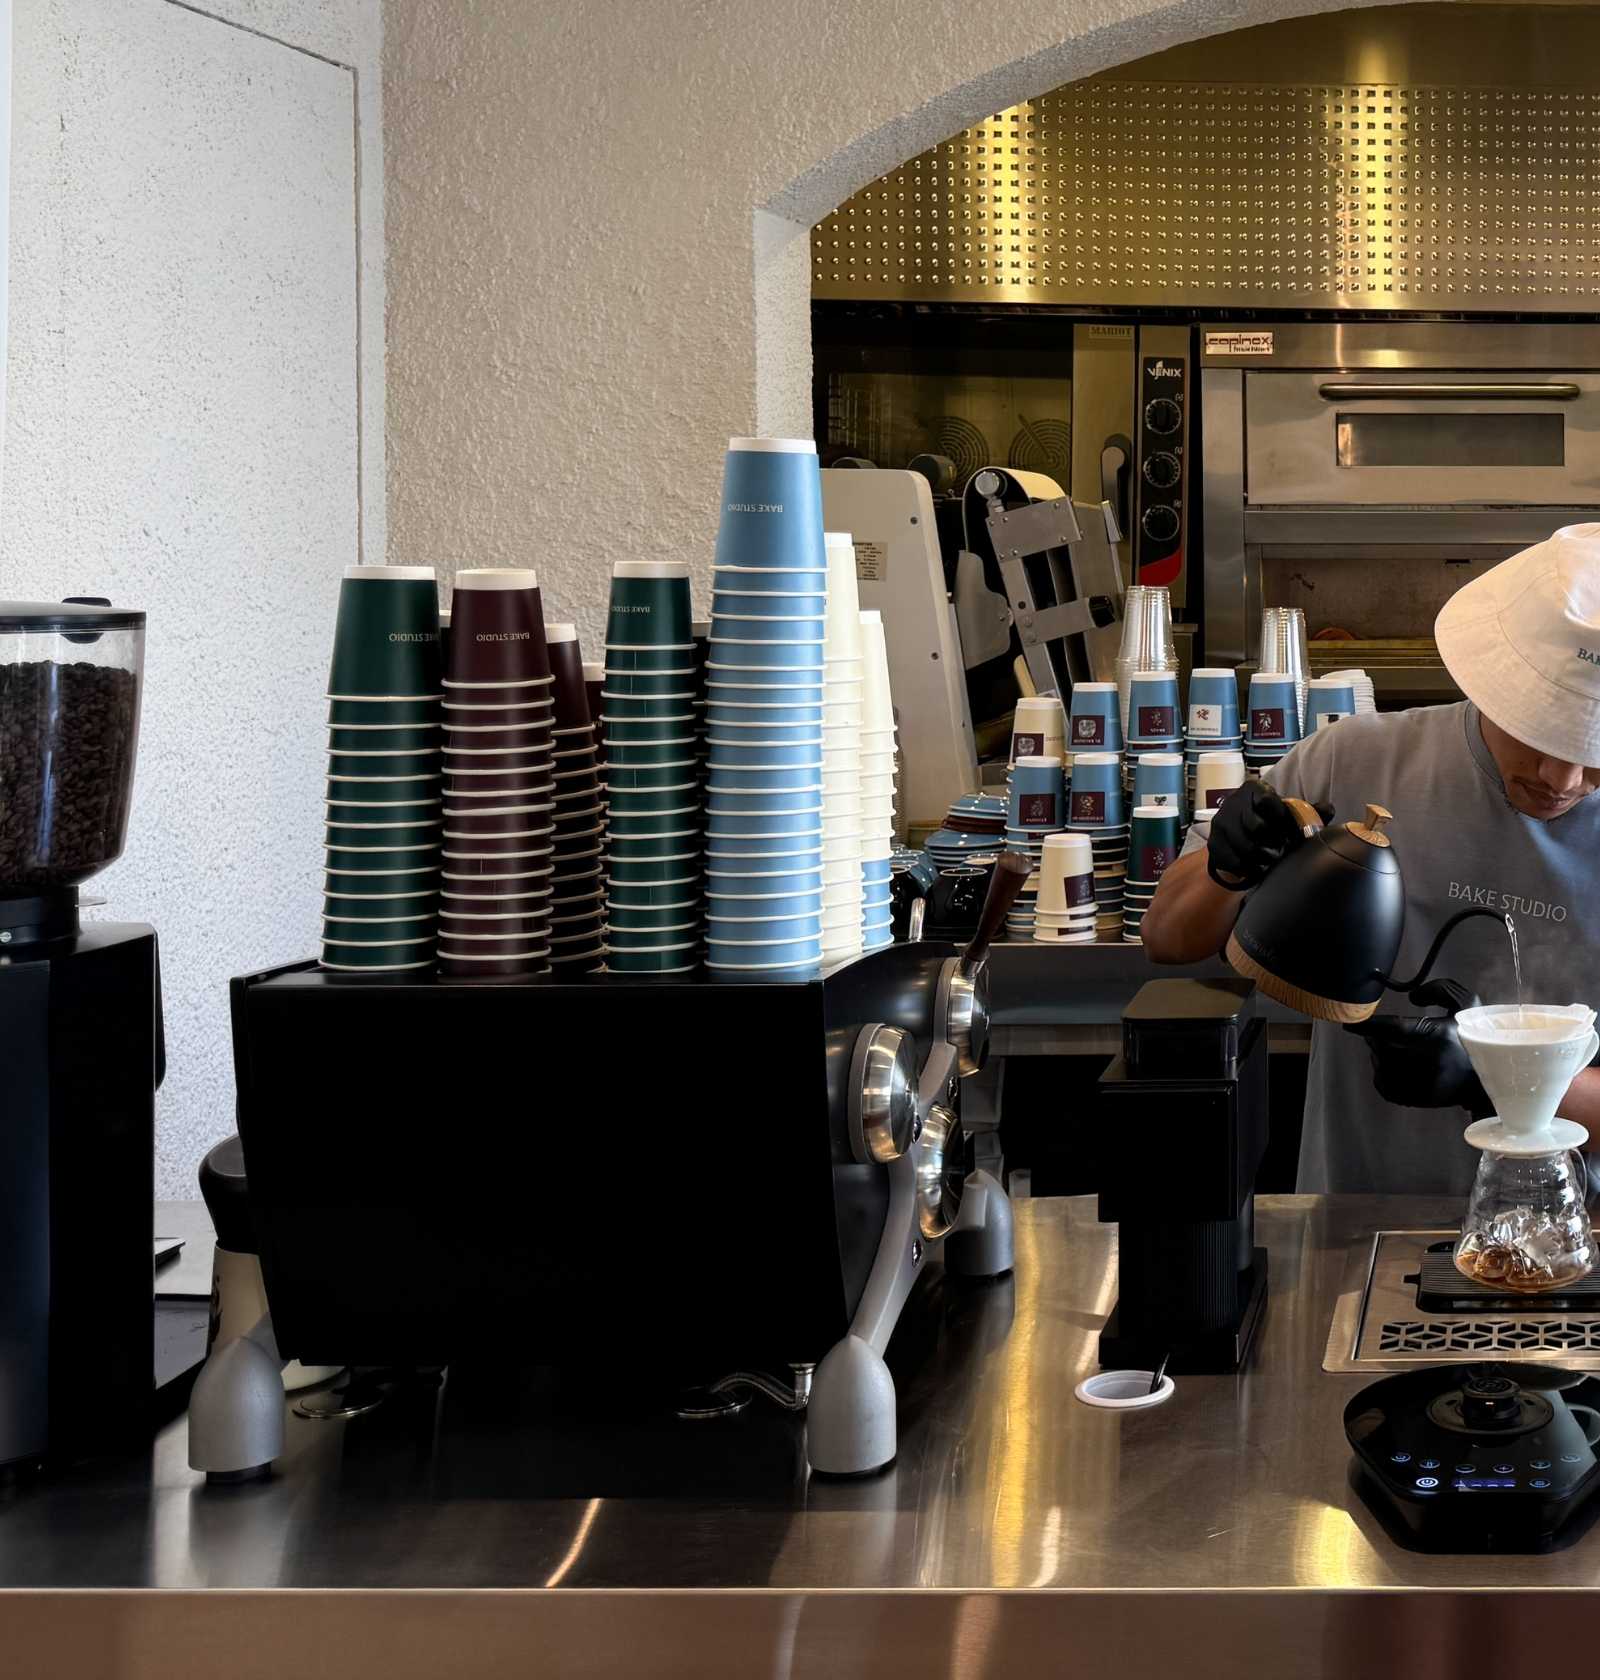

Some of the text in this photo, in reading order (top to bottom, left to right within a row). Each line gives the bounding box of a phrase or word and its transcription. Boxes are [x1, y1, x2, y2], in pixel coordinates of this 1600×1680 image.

[758, 504, 783, 513] BAKE
[388, 632, 424, 642] STUDIO
[476, 632, 530, 642] BAKE STUDIO
[1448, 881, 1567, 922] BAKE STUDIO
